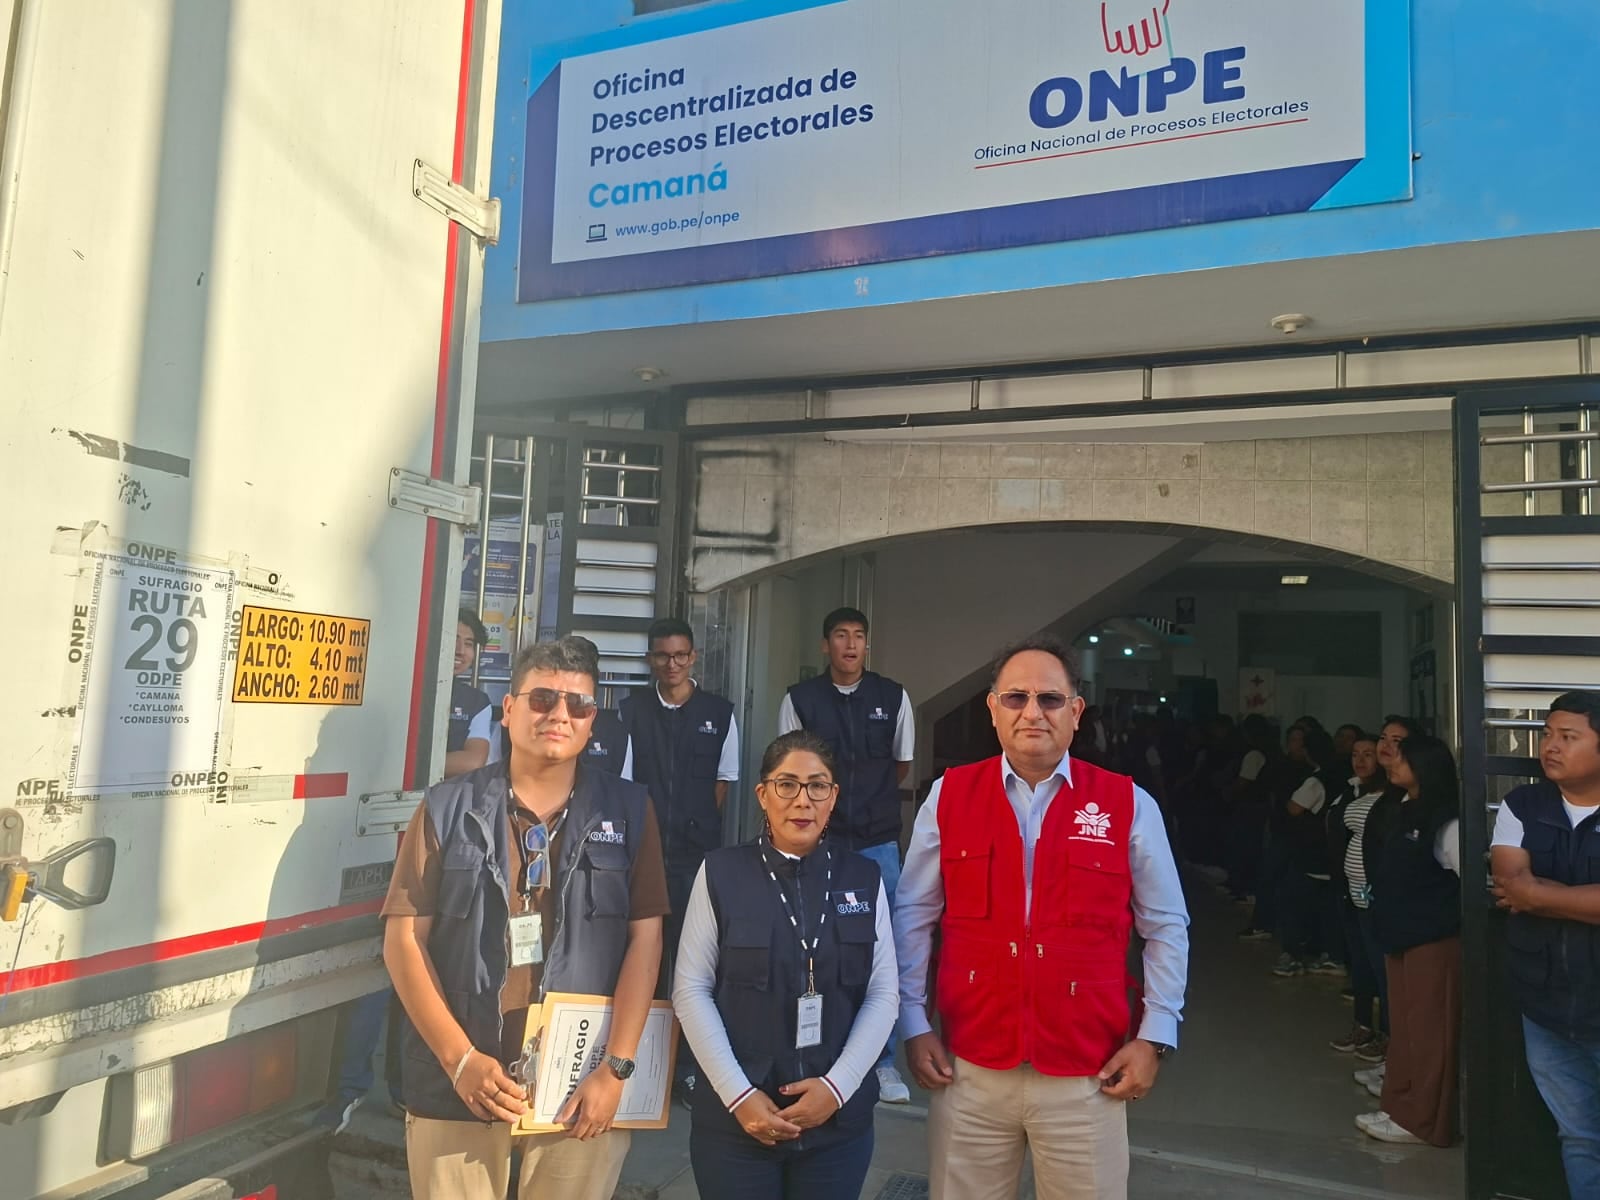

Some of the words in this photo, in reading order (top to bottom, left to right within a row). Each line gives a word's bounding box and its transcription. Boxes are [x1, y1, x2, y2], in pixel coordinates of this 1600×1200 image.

[592, 66, 685, 100] Oficina
[1028, 46, 1246, 129] ONPE
[591, 77, 812, 134] Descentralizada
[820, 67, 857, 93] de
[589, 130, 707, 167] Procesos
[714, 102, 874, 147] Electorales
[974, 141, 1027, 160] Oficina
[1031, 130, 1101, 152] Nacional
[1105, 126, 1126, 140] de
[1130, 114, 1207, 137] Procesos
[1211, 99, 1309, 126] Electorales
[588, 162, 728, 208] Camaná
[615, 210, 740, 237] www.gob.pe/onpe
[127, 543, 177, 565] ONPE
[138, 575, 203, 592] SUFRAGIO
[128, 588, 207, 618] RUTA
[68, 604, 88, 664] ONPE
[124, 614, 198, 672] 29
[228, 610, 242, 661] ONPE
[246, 612, 304, 641] LARGO:
[309, 619, 346, 645] 10.90
[349, 626, 366, 647] mt
[242, 641, 291, 669] ALTO:
[309, 647, 342, 672] 4.10
[345, 652, 363, 674] mt
[136, 672, 183, 686] ODPE
[237, 671, 300, 698] ANCHO:
[308, 675, 339, 700] 2.60
[342, 679, 360, 700] mt
[17, 779, 60, 796] NPE
[171, 772, 217, 787] ONPE
[590, 831, 624, 844] ONPE
[1078, 824, 1107, 838] JNE
[837, 901, 870, 914] ONPE
[564, 1019, 589, 1104] UFRAGIO
[588, 1045, 600, 1073] DPE
